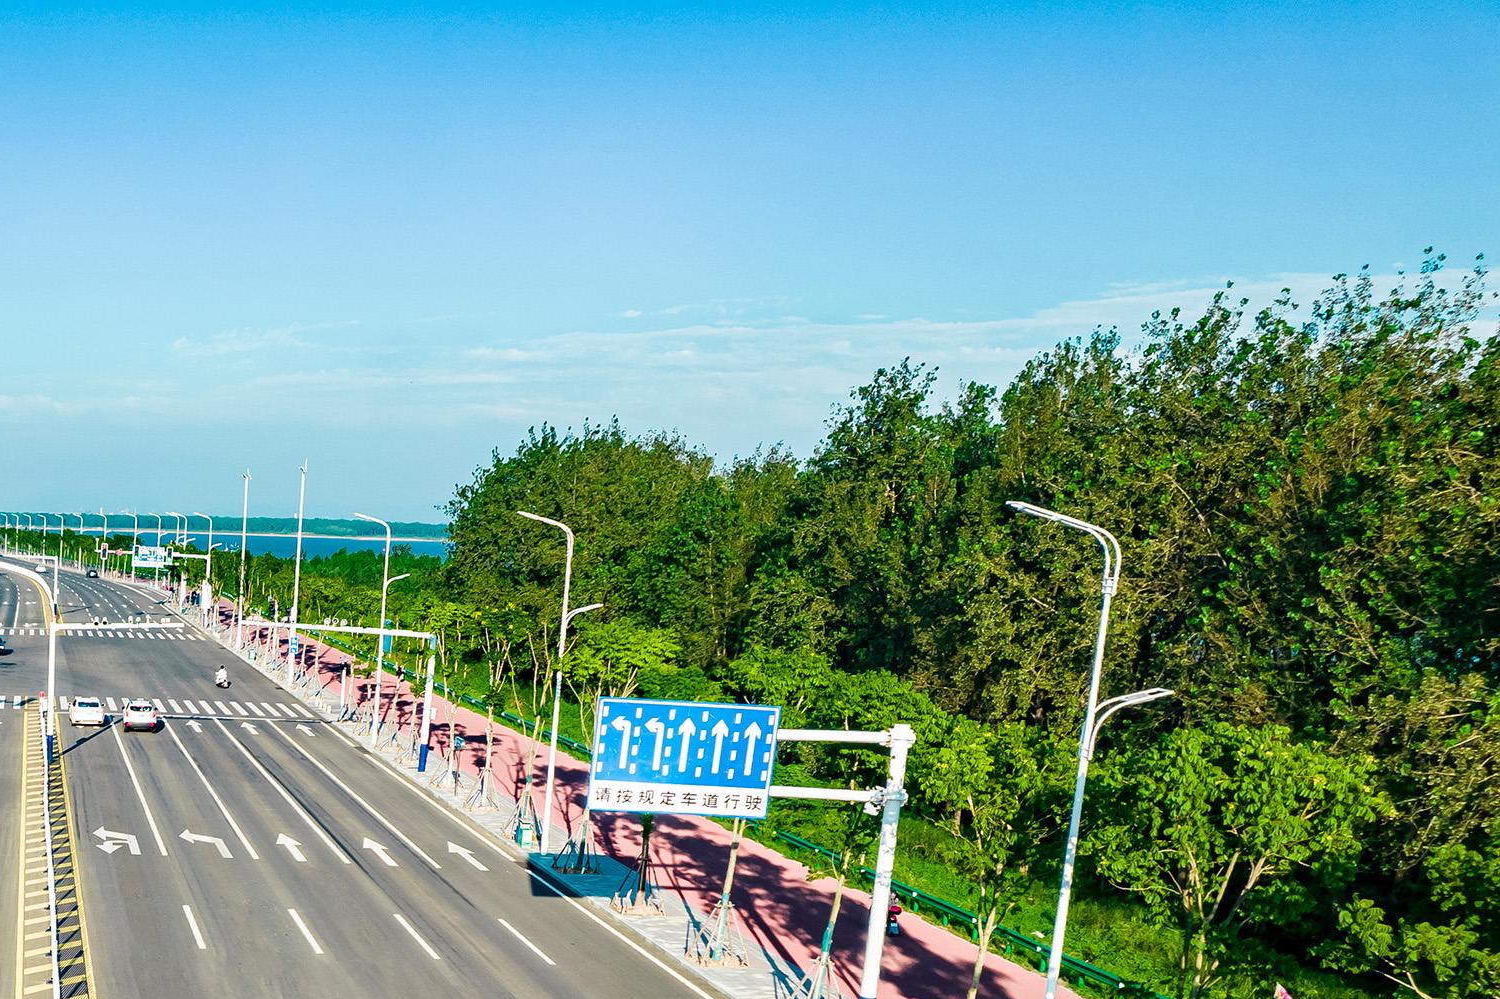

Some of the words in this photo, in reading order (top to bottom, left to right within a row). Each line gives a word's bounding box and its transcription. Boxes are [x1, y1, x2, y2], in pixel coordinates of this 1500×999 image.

[596, 787, 762, 810] 请按规定车道行驶
